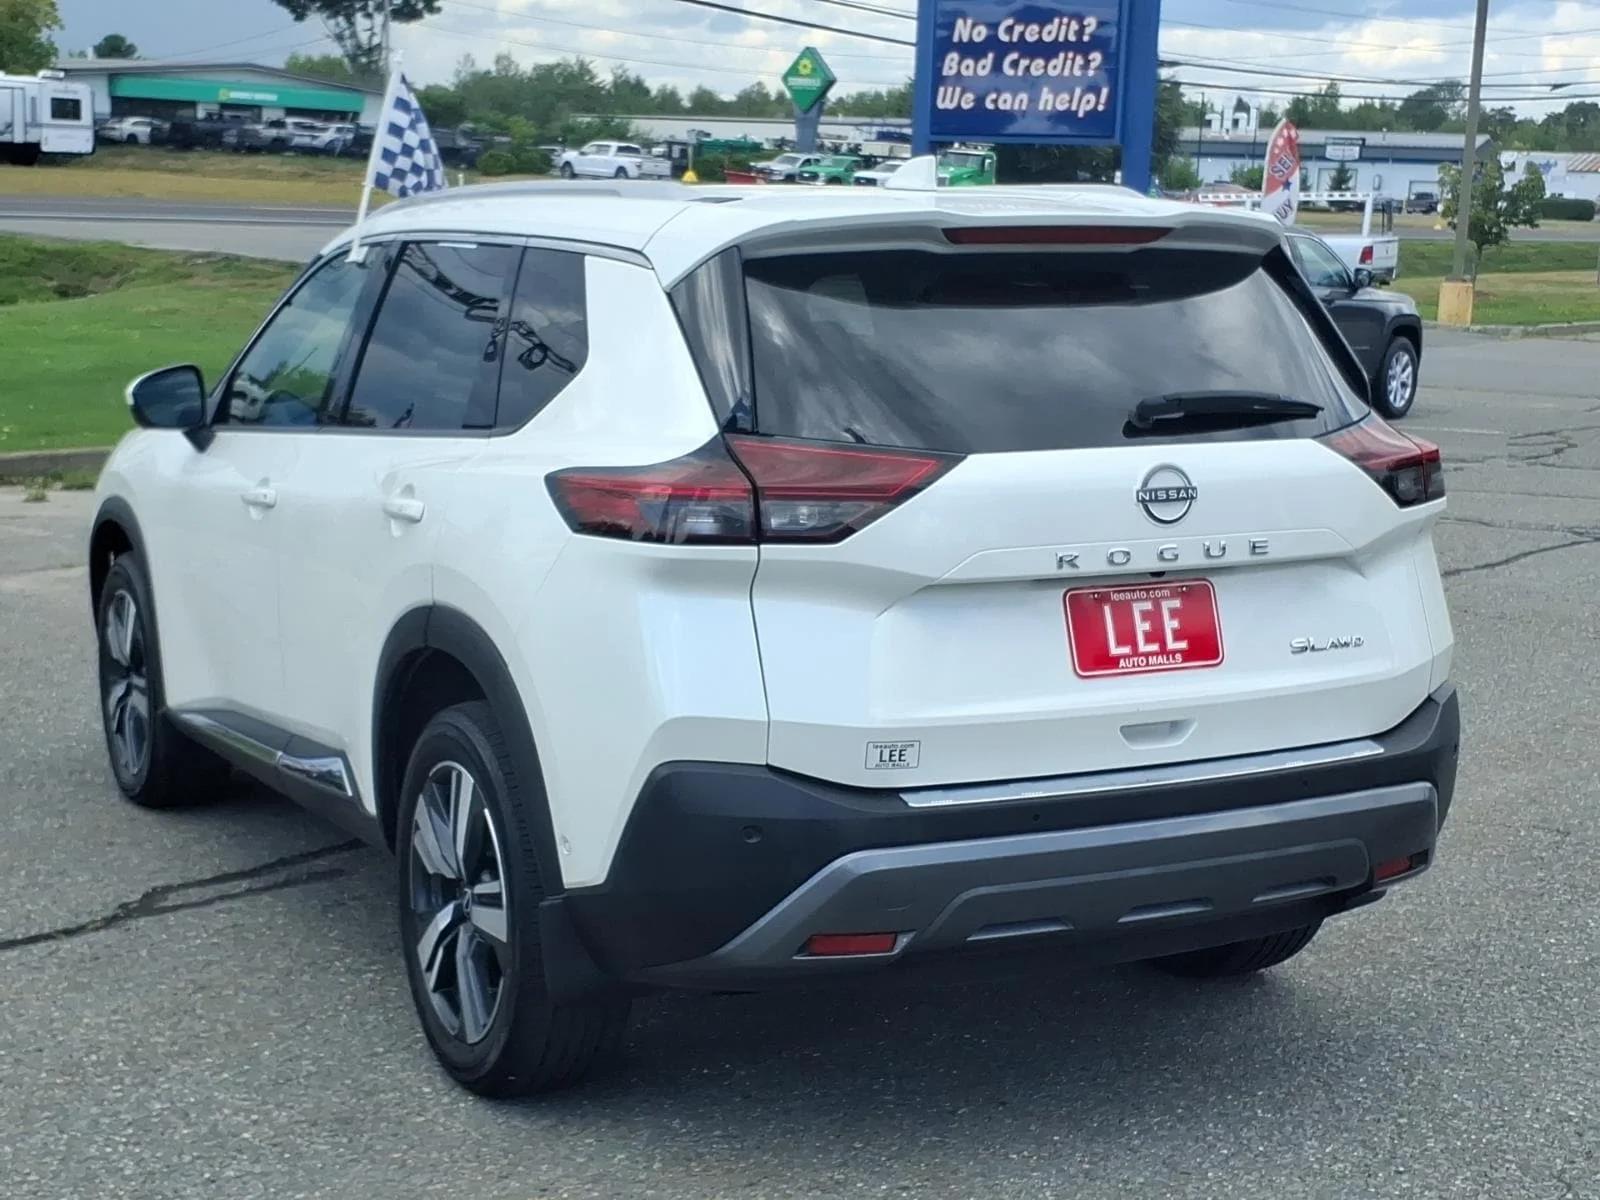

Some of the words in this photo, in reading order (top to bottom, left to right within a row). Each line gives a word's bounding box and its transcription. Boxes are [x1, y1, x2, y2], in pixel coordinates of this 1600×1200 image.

[952, 17, 988, 43] No
[997, 16, 1098, 43] Credit?
[942, 52, 995, 77] Bad
[1002, 51, 1102, 77] Credit?
[936, 86, 976, 111] We
[984, 92, 1028, 111] can
[1038, 86, 1109, 118] help!
[1137, 487, 1198, 503] NISSAN
[1056, 538, 1270, 570] ROGUE
[1110, 588, 1171, 602] leeauto.com
[1103, 598, 1189, 657] LEE
[1119, 656, 1147, 669] AUTO
[1148, 653, 1183, 667] MALLS
[879, 749, 908, 763] LEE
